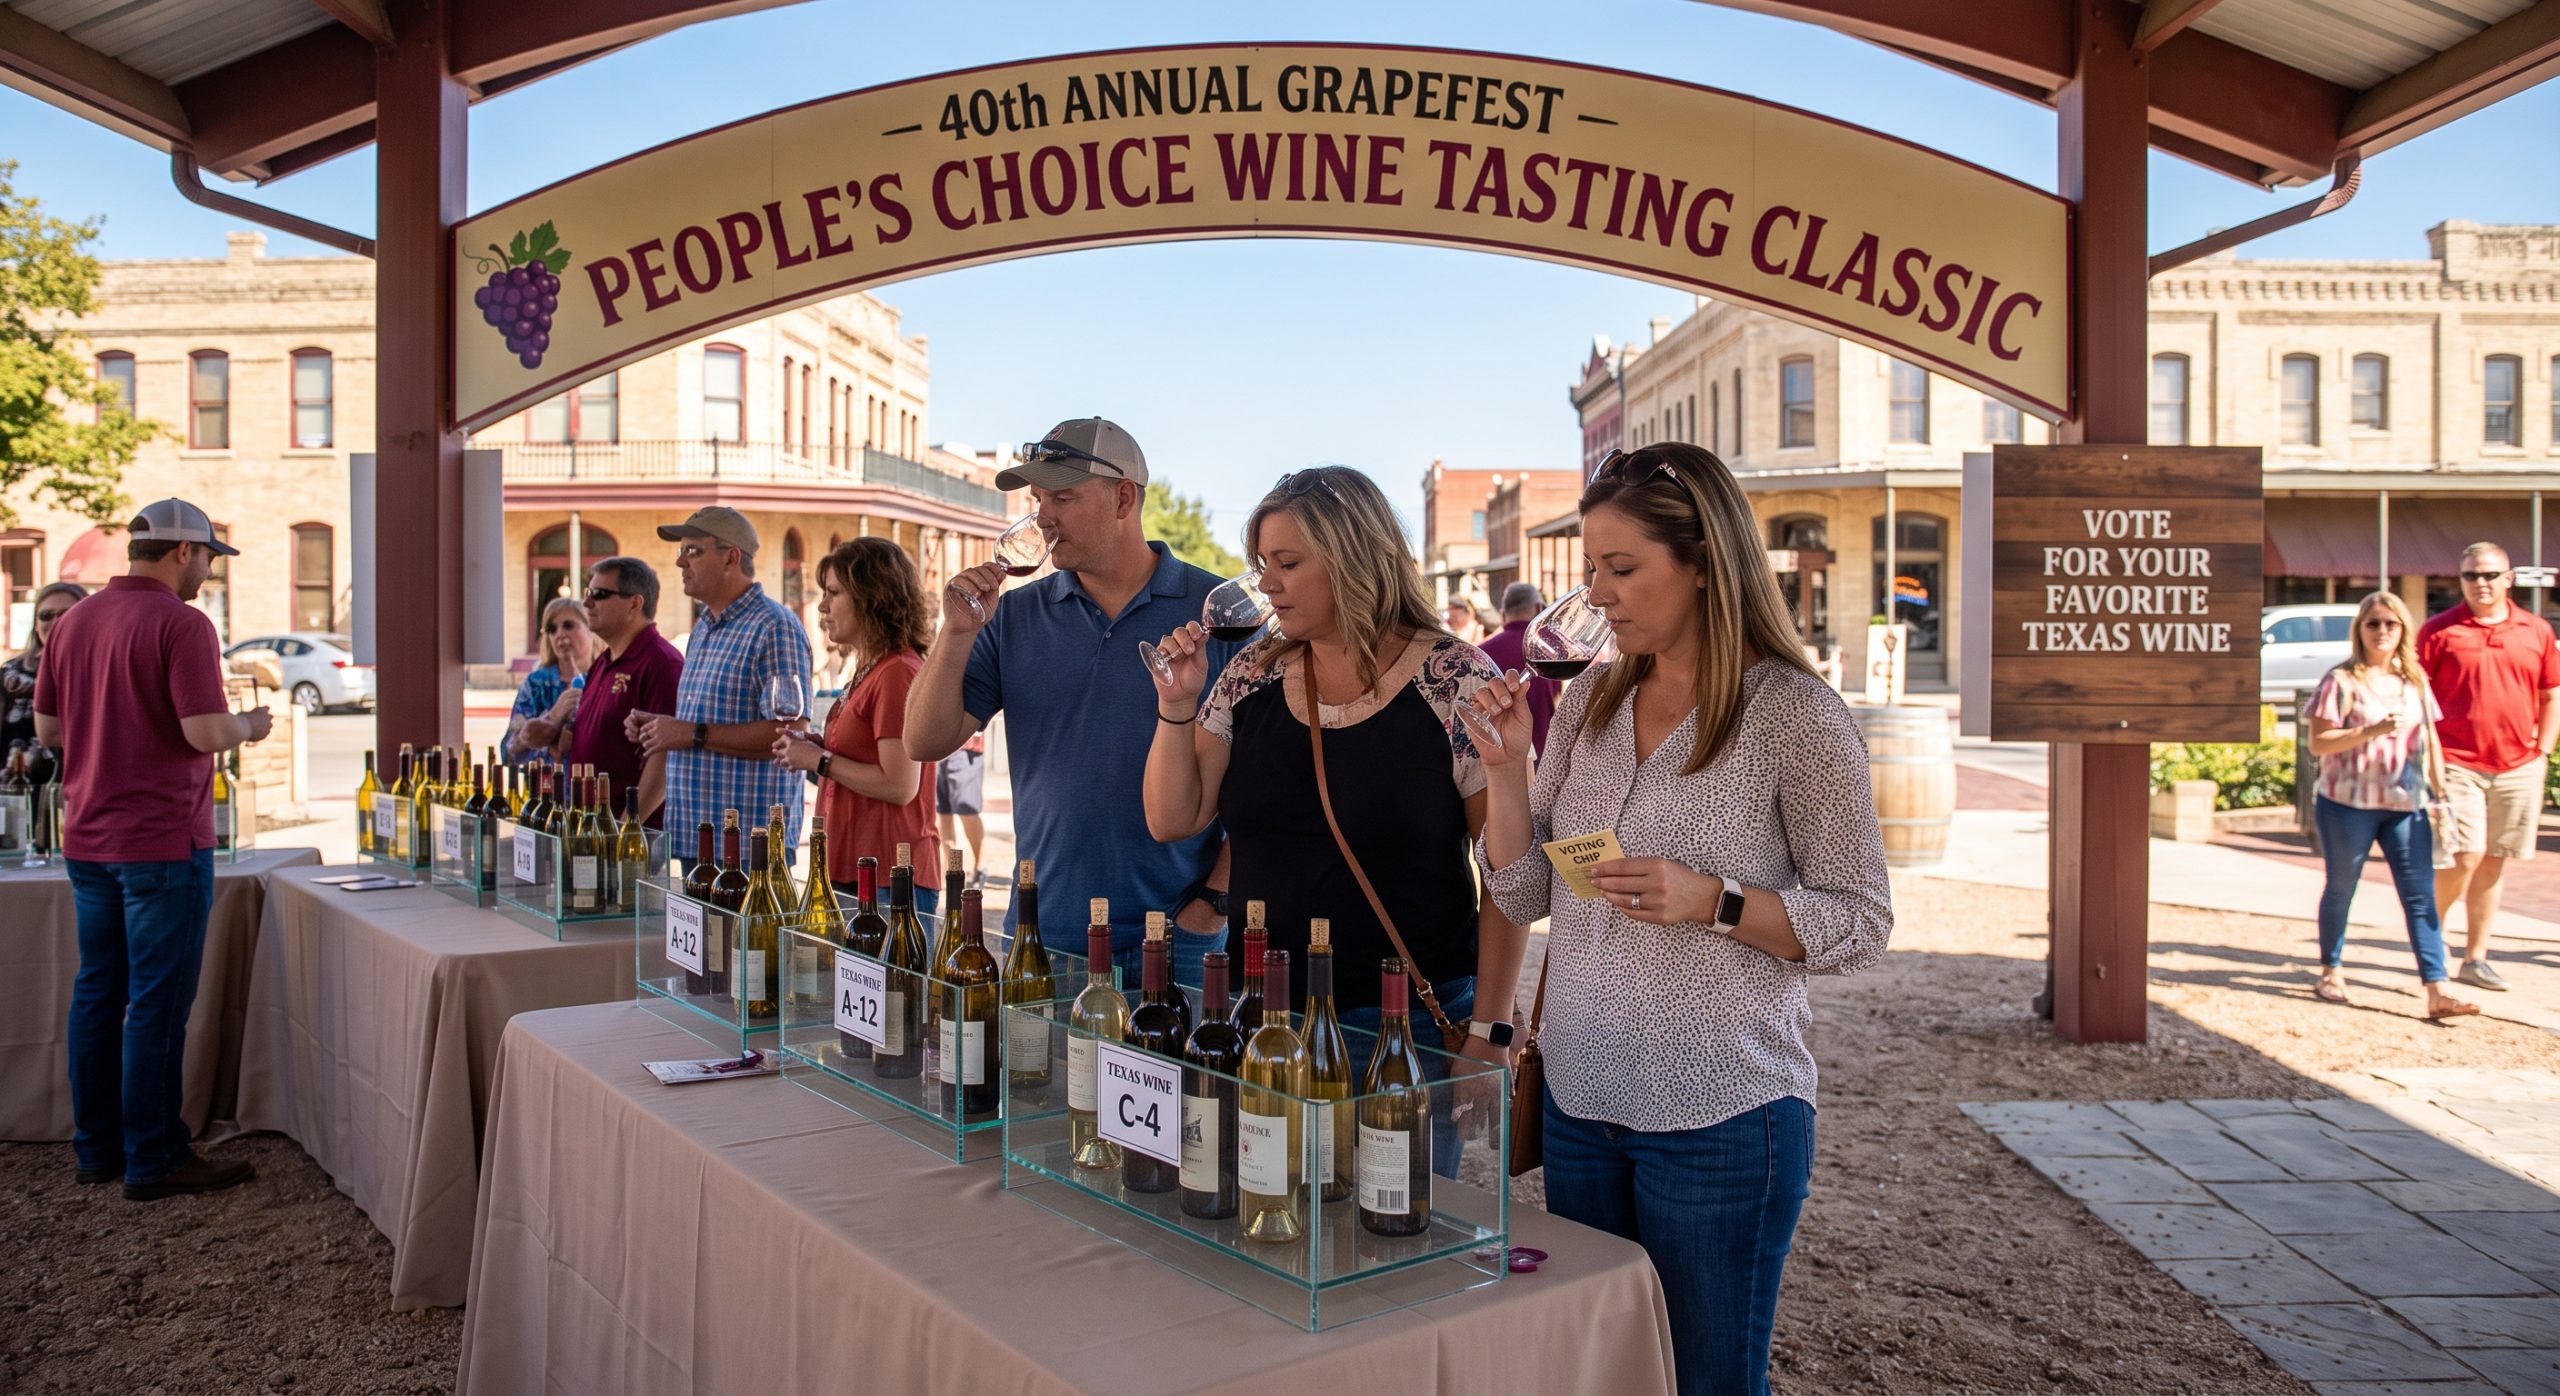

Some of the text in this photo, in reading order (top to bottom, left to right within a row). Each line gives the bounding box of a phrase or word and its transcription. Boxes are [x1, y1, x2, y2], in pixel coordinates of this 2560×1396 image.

[939, 65, 1564, 141] 40th ANNUAL GRAPEFEST
[583, 132, 2042, 361] PEOPLE'S CHOICE WINE TASTING CLASSIC
[2082, 510, 2172, 540] VOTE
[2043, 547, 2212, 577] FOR YOUR
[2045, 585, 2209, 615] FAVORITE
[2022, 622, 2231, 652] TEXAS WINE
[1558, 838, 1606, 856] VOTING
[1573, 852, 1601, 865] CHIP
[671, 925, 697, 957] A-12
[841, 967, 882, 992] TEXAS WINE
[841, 989, 878, 1027] A-12
[1106, 1061, 1141, 1085] TEXAS
[1143, 1072, 1173, 1095] WINE
[1118, 1093, 1161, 1138] C-4
